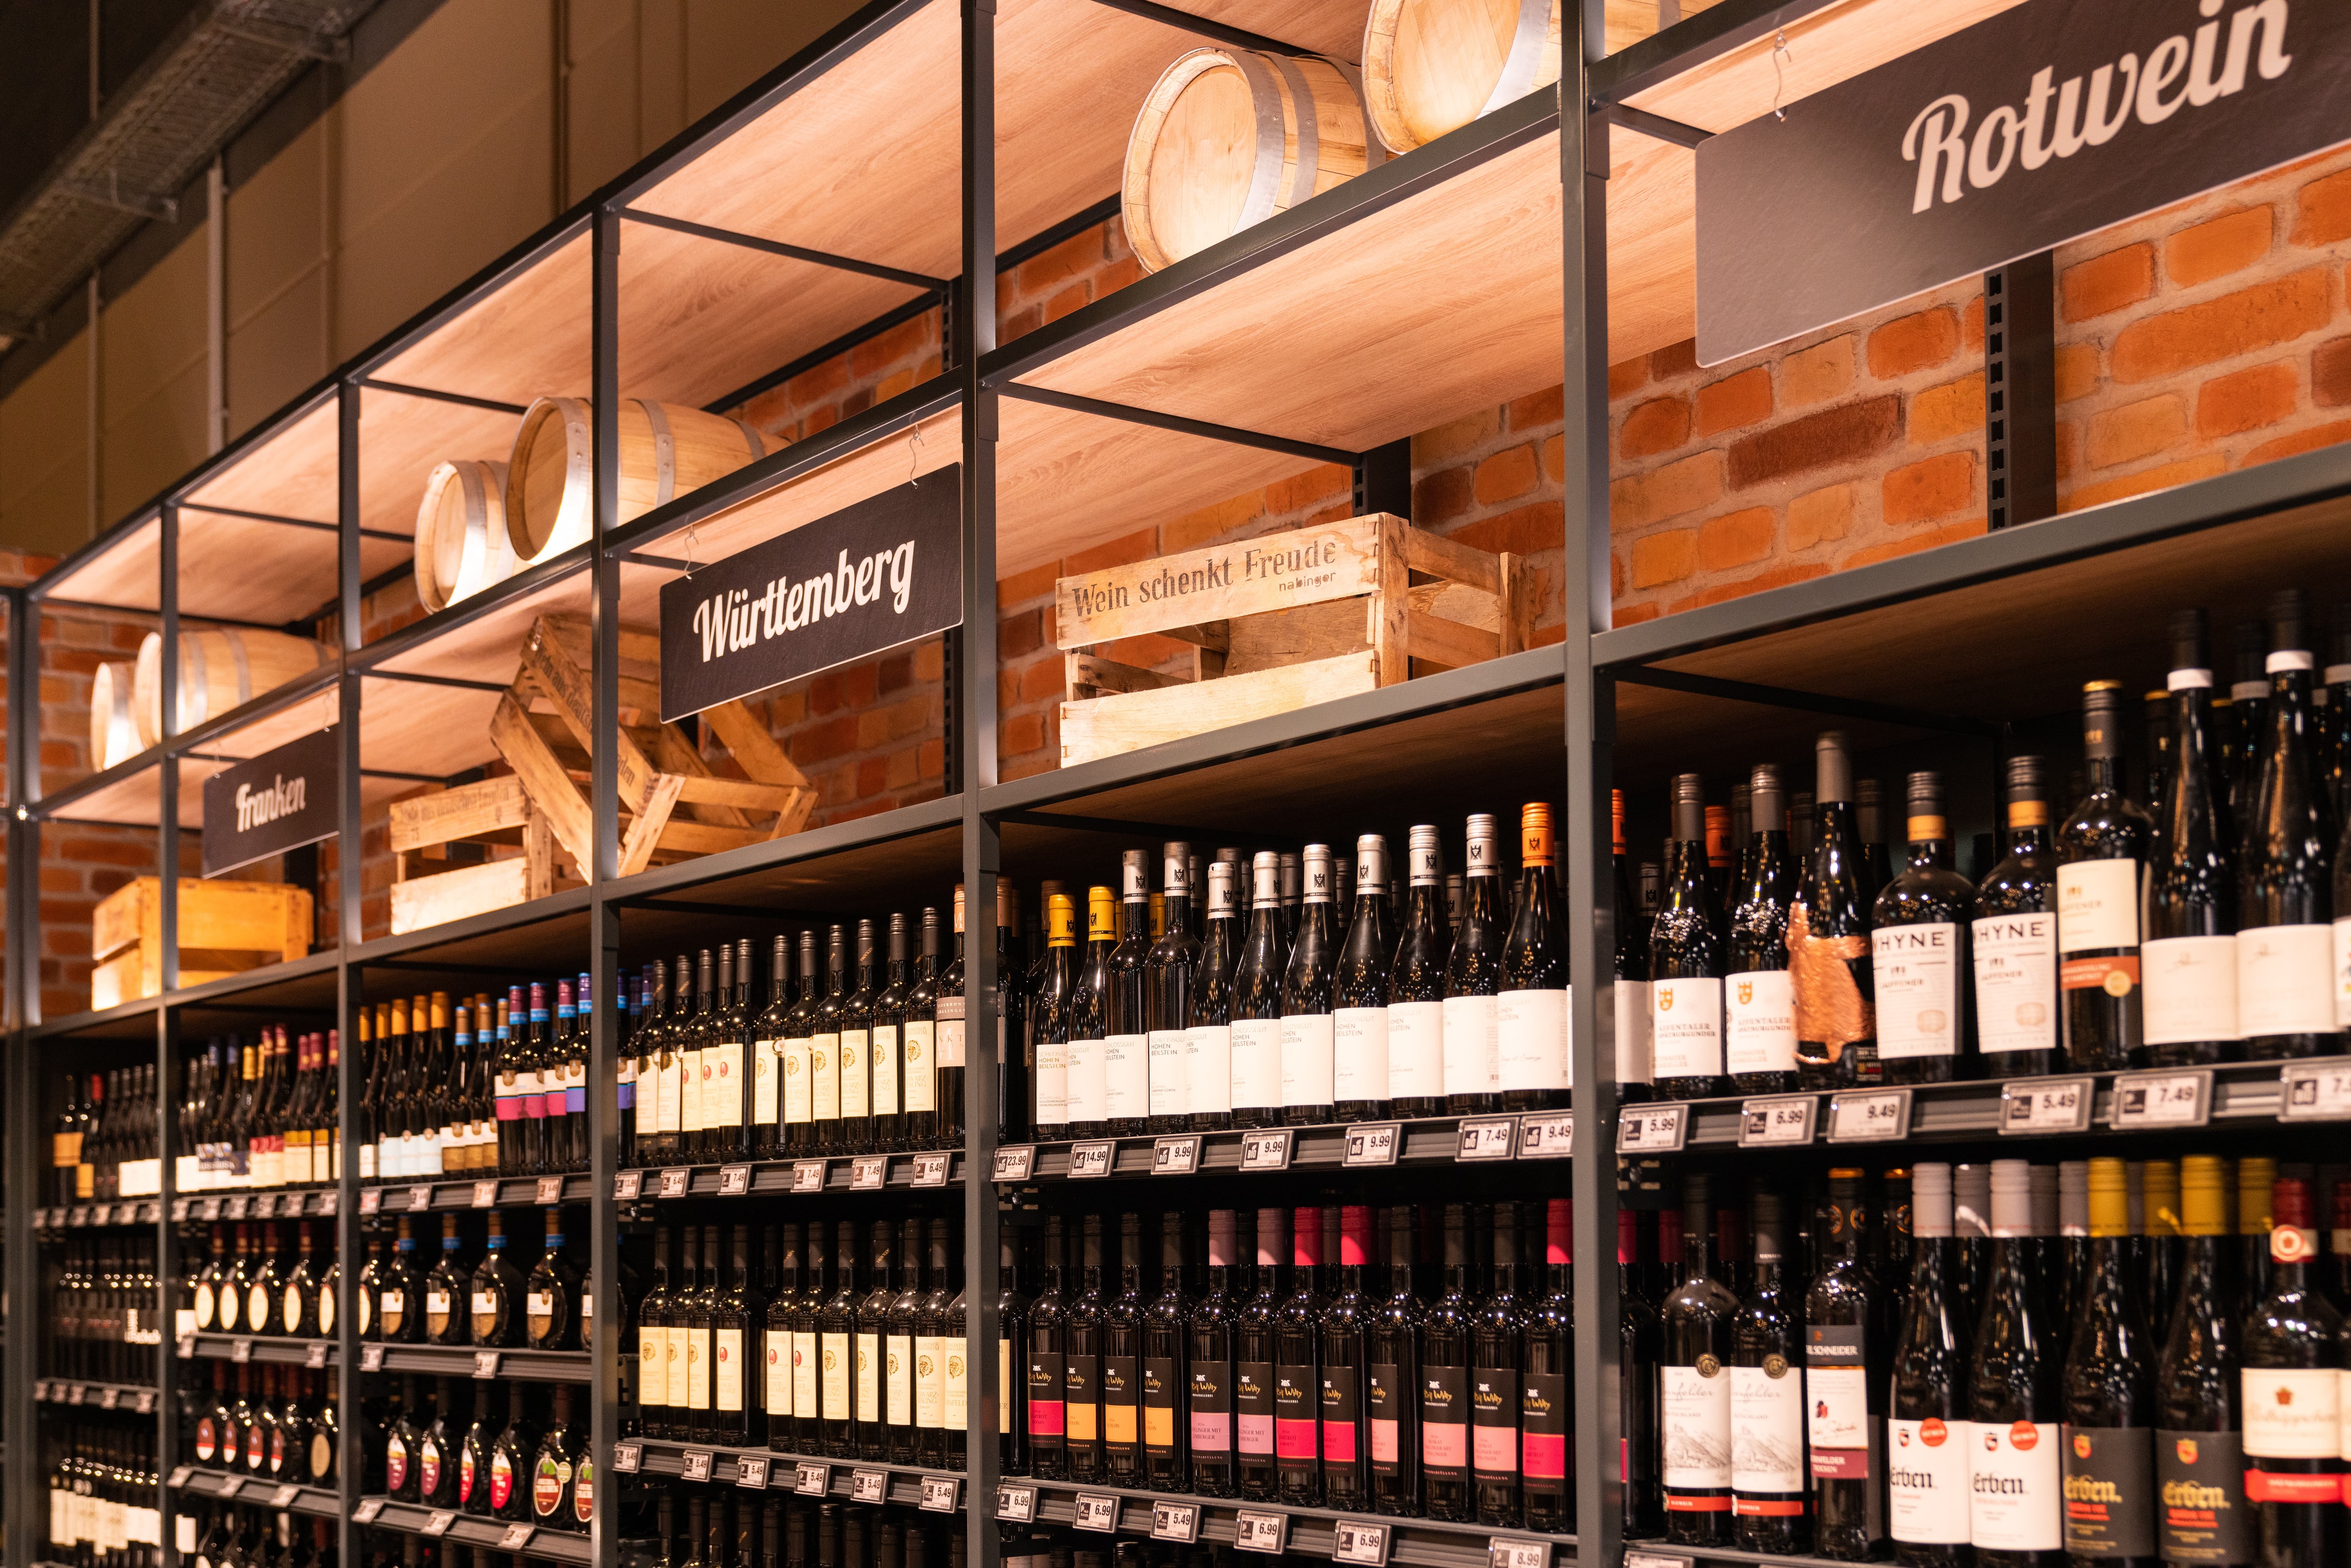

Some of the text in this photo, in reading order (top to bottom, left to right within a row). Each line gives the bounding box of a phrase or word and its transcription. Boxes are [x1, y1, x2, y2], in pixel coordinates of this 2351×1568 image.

[1901, 0, 2292, 213] Rotwein
[1072, 540, 1336, 616] Wein schenkt Freude
[1279, 571, 1336, 591] nabinger
[694, 540, 915, 662] Württemberg
[2160, 1087, 2193, 1103] 7.49
[2042, 1094, 2076, 1109] 5.49
[1776, 1110, 1803, 1124] 6.99
[1867, 1104, 1896, 1119] 9.49
[1649, 1118, 1675, 1132] 5.99
[1486, 1129, 1508, 1141] 7.49
[1548, 1125, 1571, 1138] 9.49
[1370, 1135, 1390, 1147] 9.99
[1464, 1137, 1476, 1148] BIO
[1526, 1134, 1539, 1146] BIO
[1174, 1146, 1192, 1157] 9.99
[1264, 1141, 1283, 1152] 9.99
[1351, 1144, 1362, 1154] BIO
[1086, 1151, 1106, 1162] 14.99
[1247, 1150, 1256, 1158] BIO
[1007, 1155, 1026, 1166] 23.99
[868, 1166, 880, 1175] 7.49
[929, 1162, 943, 1173] 6.49
[733, 1173, 745, 1182] 7.49
[808, 1169, 820, 1179] 7.49
[1036, 1372, 1052, 1382] Willy
[1071, 1375, 1085, 1385] Willy
[1110, 1376, 1125, 1387] Willy
[1148, 1378, 1161, 1389] Willy
[1200, 1382, 1217, 1393] Willy
[1245, 1384, 1261, 1395] Willy
[1285, 1387, 1302, 1399] Willy
[1327, 1389, 1342, 1401] Willy
[1433, 1389, 1452, 1403] Willy
[1483, 1392, 1503, 1406] Willy
[1531, 1398, 1551, 1411] Willy
[751, 1465, 763, 1475] 5.49
[810, 1472, 823, 1482] 5.49
[1973, 1471, 2025, 1494] Erben
[867, 1478, 881, 1489] 5.49
[937, 1487, 952, 1498] 5.49
[1014, 1495, 1029, 1506] 6.99
[1095, 1504, 1111, 1516] 6.99
[1174, 1513, 1191, 1525] 5.49
[1259, 1523, 1278, 1536] 6.99
[1360, 1534, 1380, 1548] 6.99
[1517, 1552, 1540, 1566] 8.99
